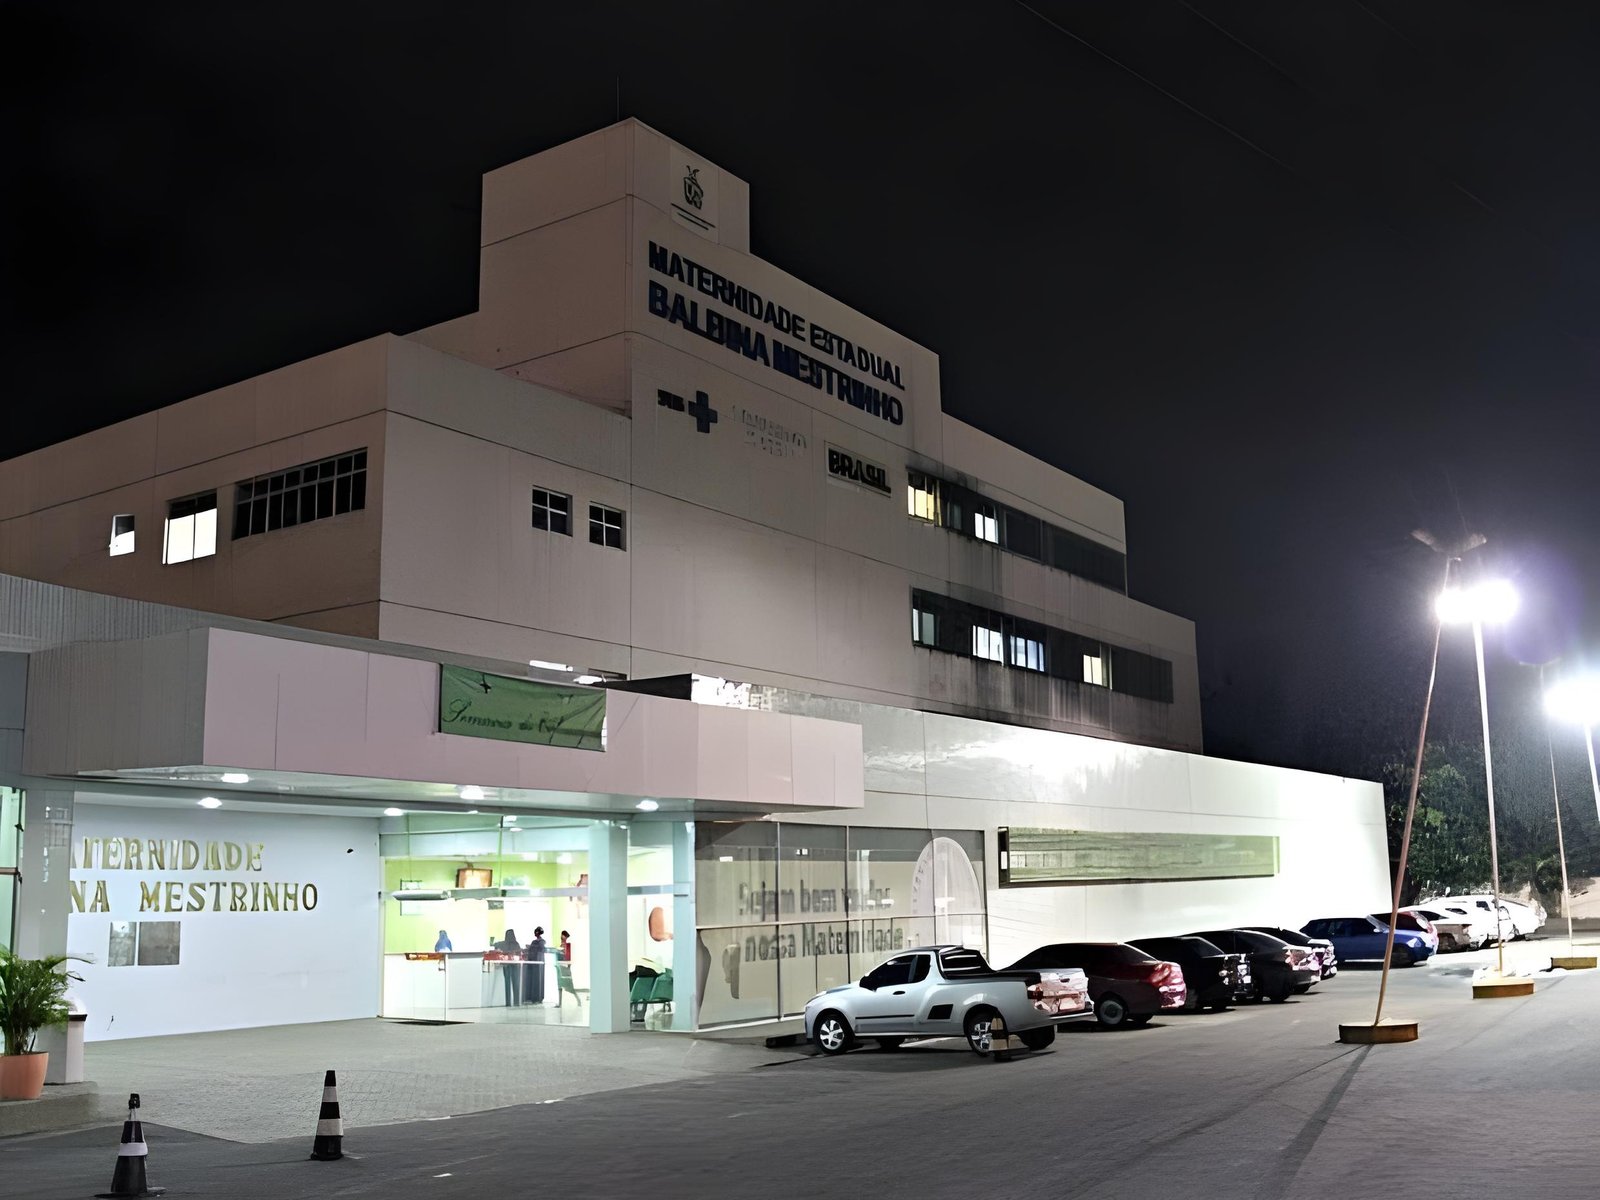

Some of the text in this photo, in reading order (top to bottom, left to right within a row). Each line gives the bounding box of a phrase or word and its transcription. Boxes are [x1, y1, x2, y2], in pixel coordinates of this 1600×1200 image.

[649, 240, 905, 391] MATERNIDADE ESTADUAL
[649, 279, 904, 426] BALBINA MESTRINHO
[828, 448, 891, 494] BRASIL
[71, 837, 265, 871] TERNIDADE
[139, 881, 318, 913] MESTRINHO
